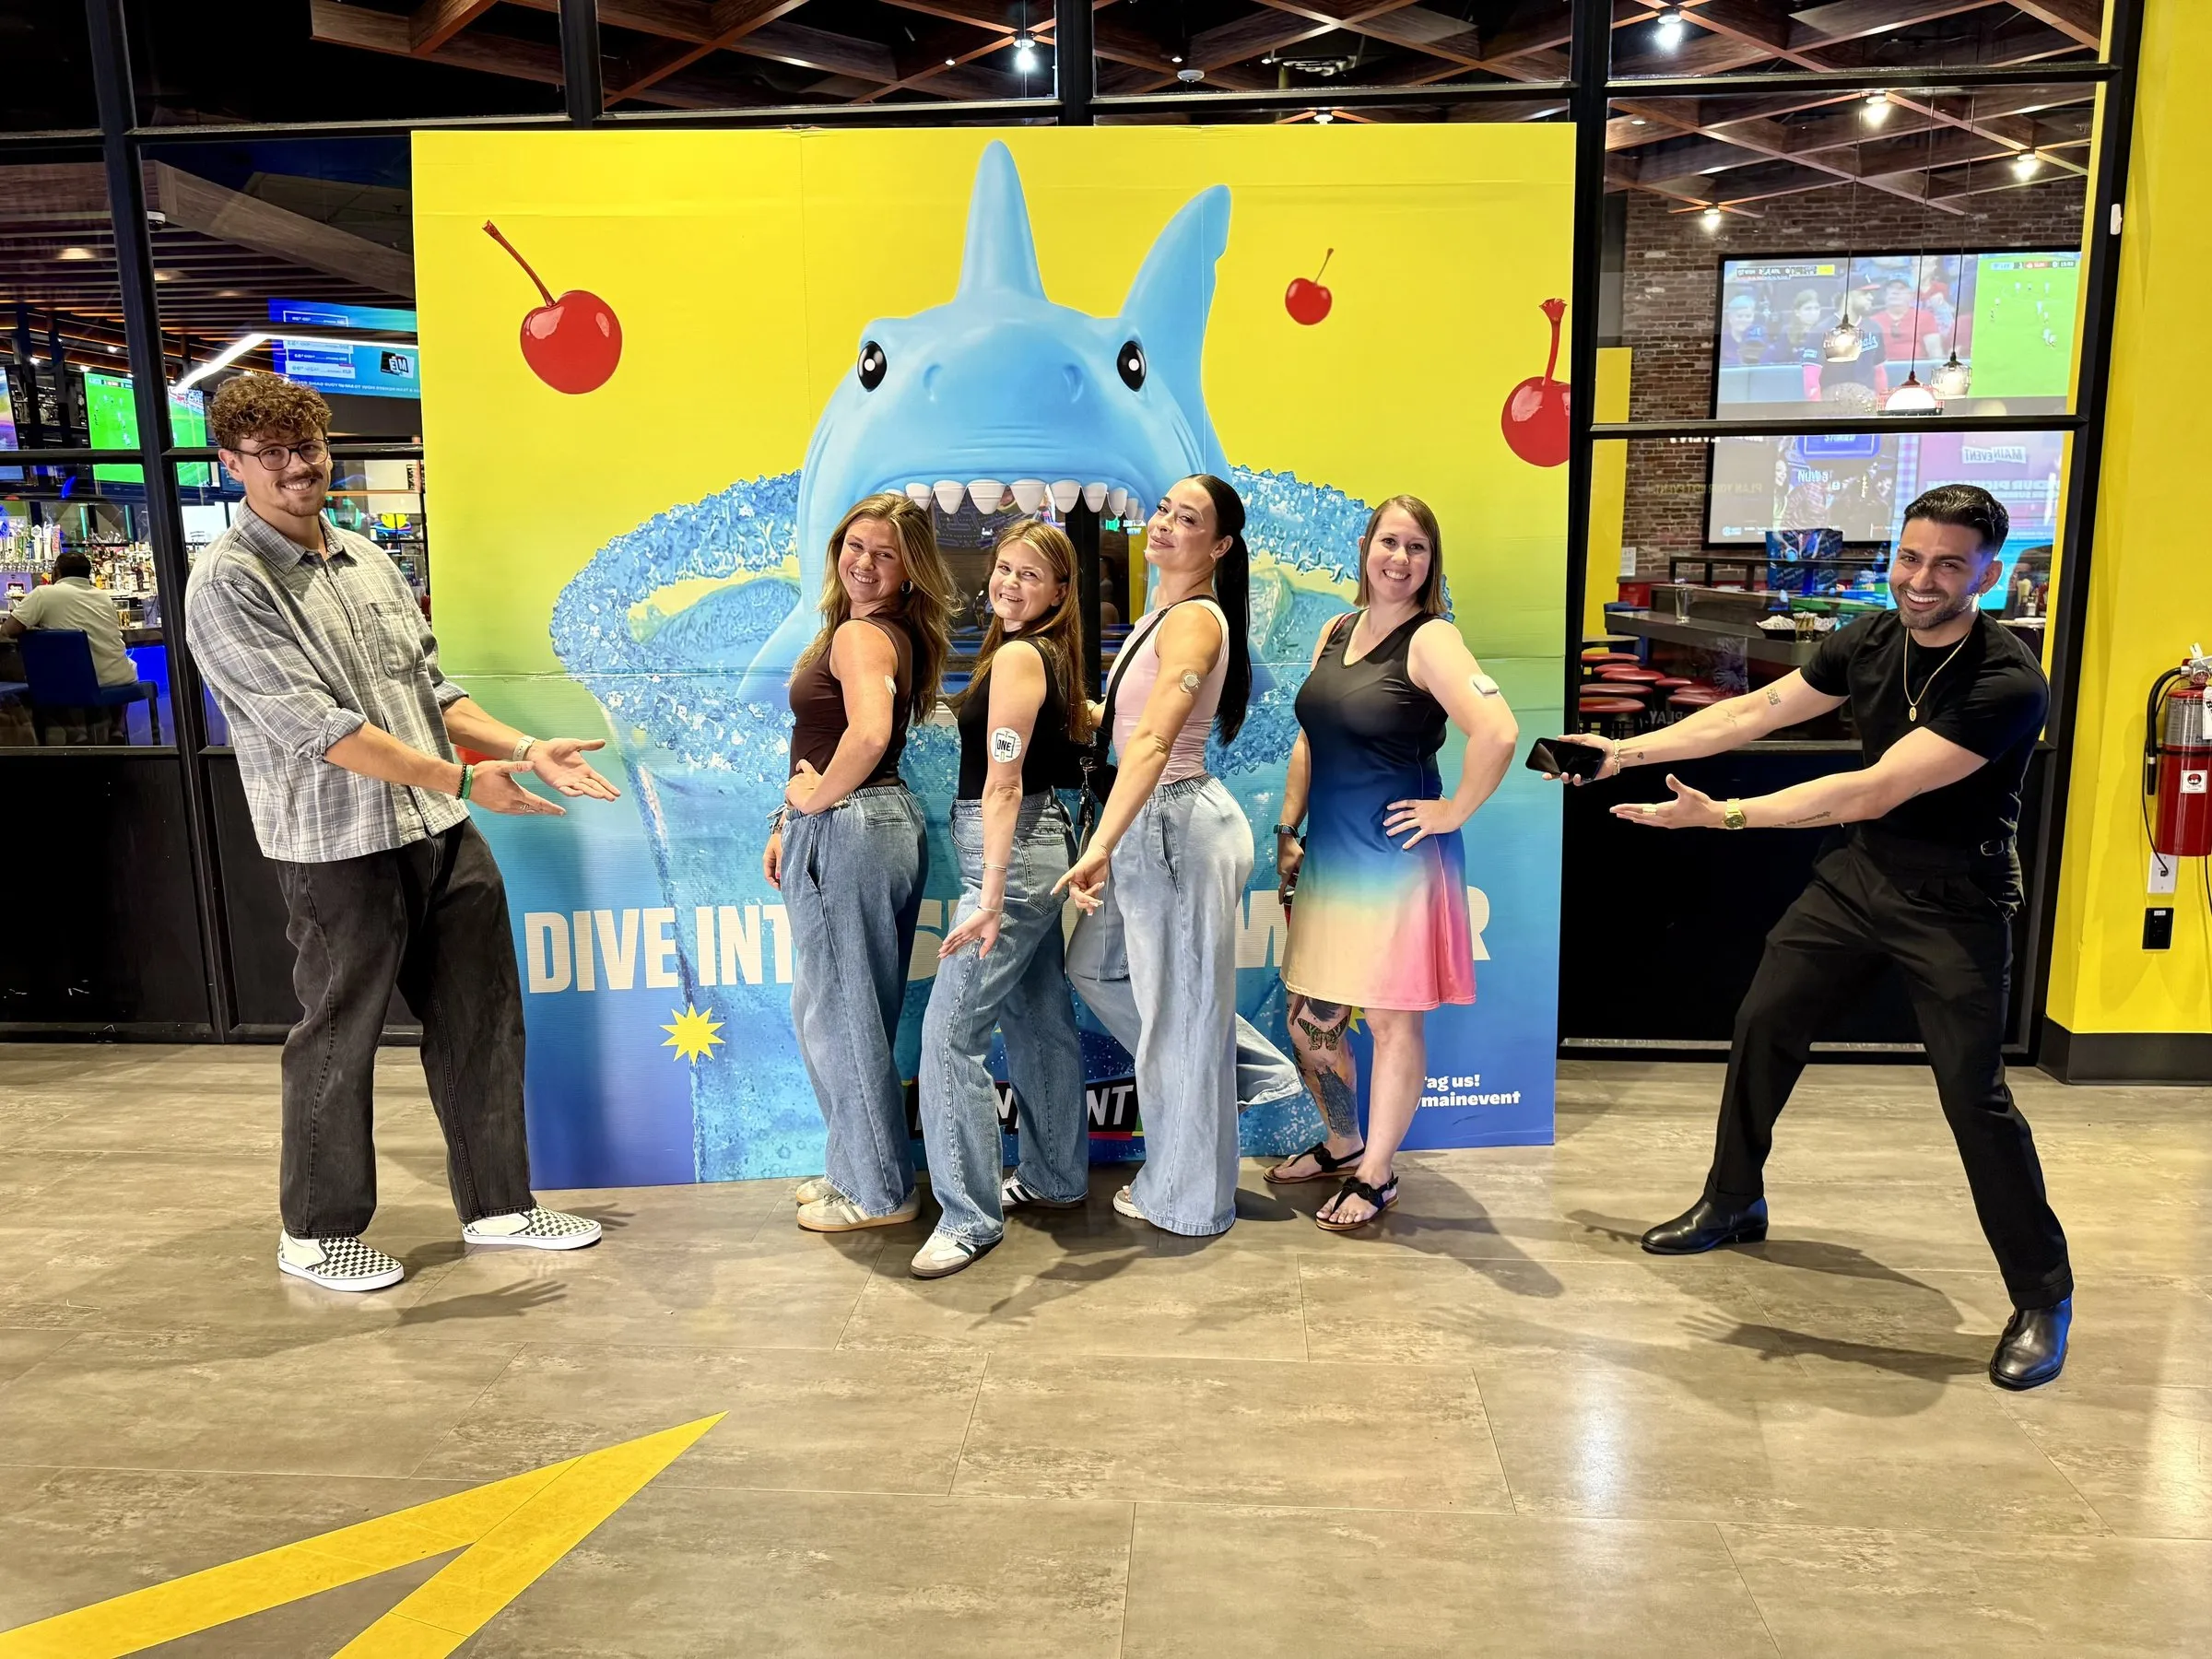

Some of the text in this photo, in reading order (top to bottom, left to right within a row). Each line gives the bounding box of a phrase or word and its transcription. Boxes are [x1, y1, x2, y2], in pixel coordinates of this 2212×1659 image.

[996, 739, 1012, 751] ONE
[524, 904, 794, 994] DIVE INT
[1424, 1074, 1480, 1092] ag us!
[1416, 1090, 1522, 1112] mainevent
